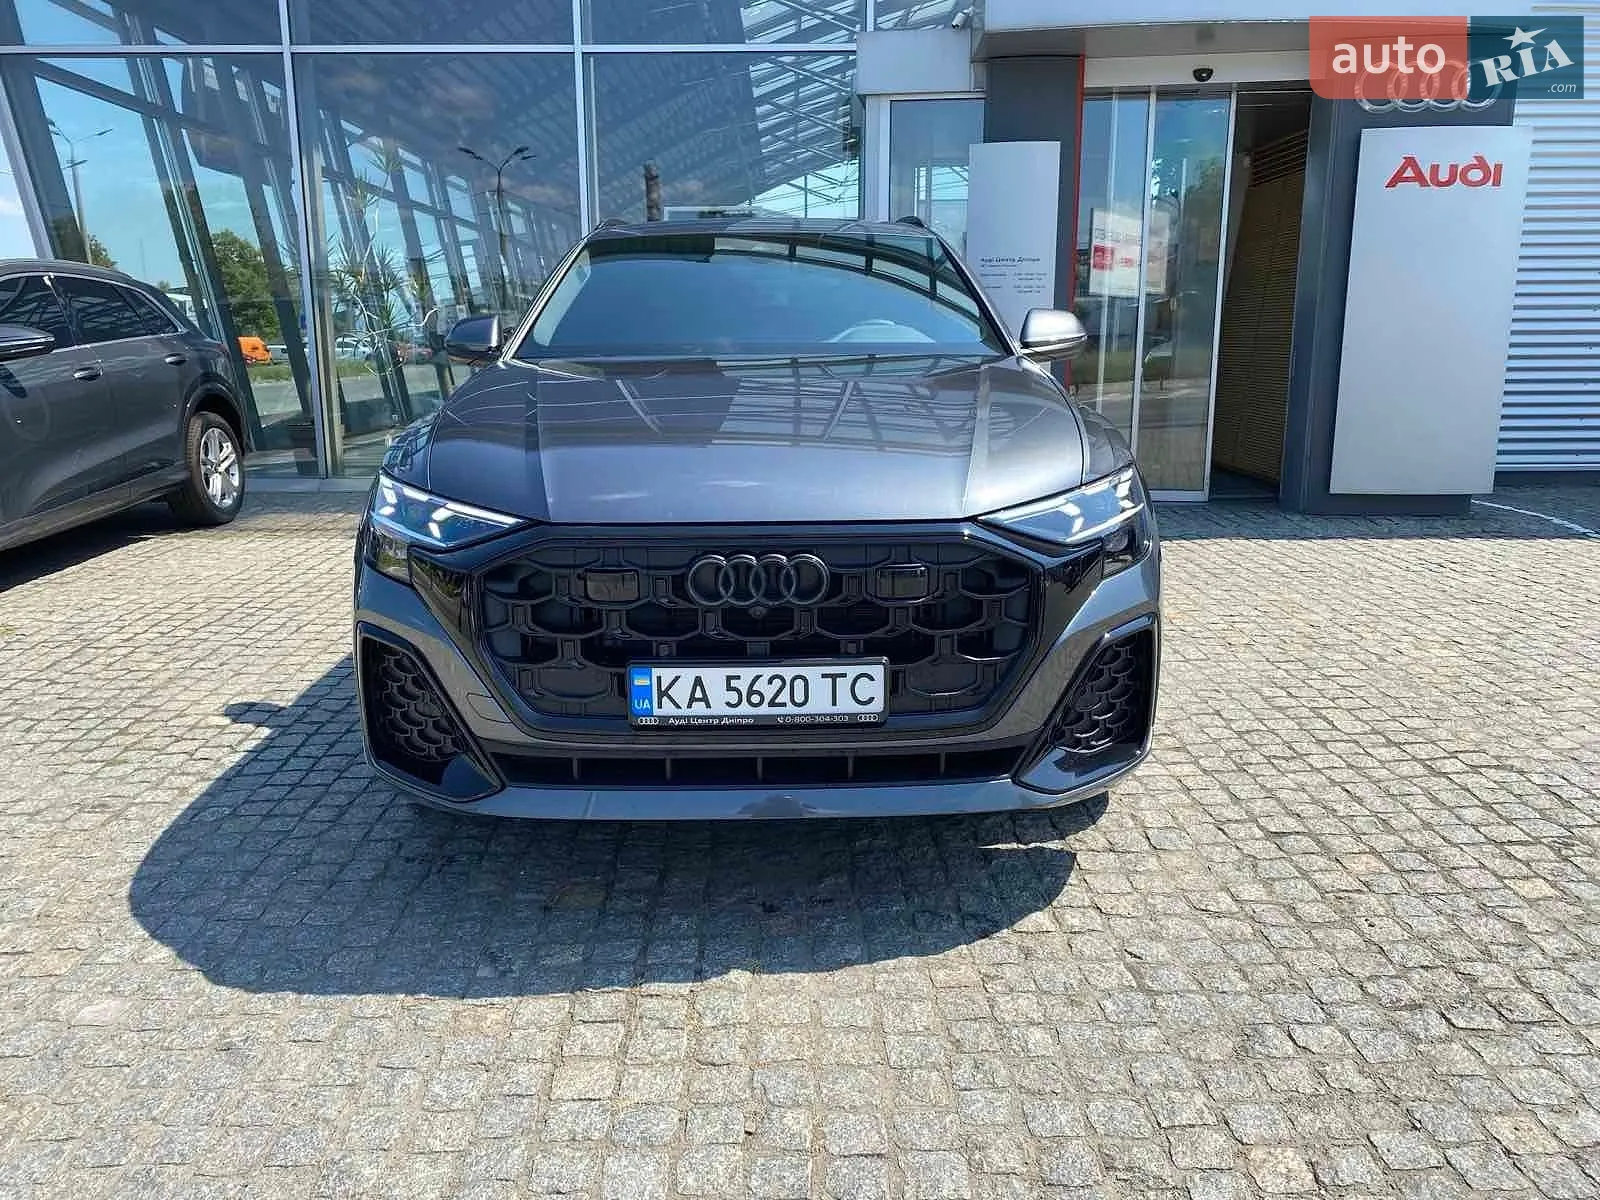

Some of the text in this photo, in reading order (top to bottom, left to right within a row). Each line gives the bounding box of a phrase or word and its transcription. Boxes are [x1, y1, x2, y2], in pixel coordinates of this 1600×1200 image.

[1385, 155, 1503, 189] Audi
[656, 672, 876, 709] KA 5620 TC
[634, 698, 651, 710] UA
[668, 717, 754, 726] Ауді Центр Дніпро
